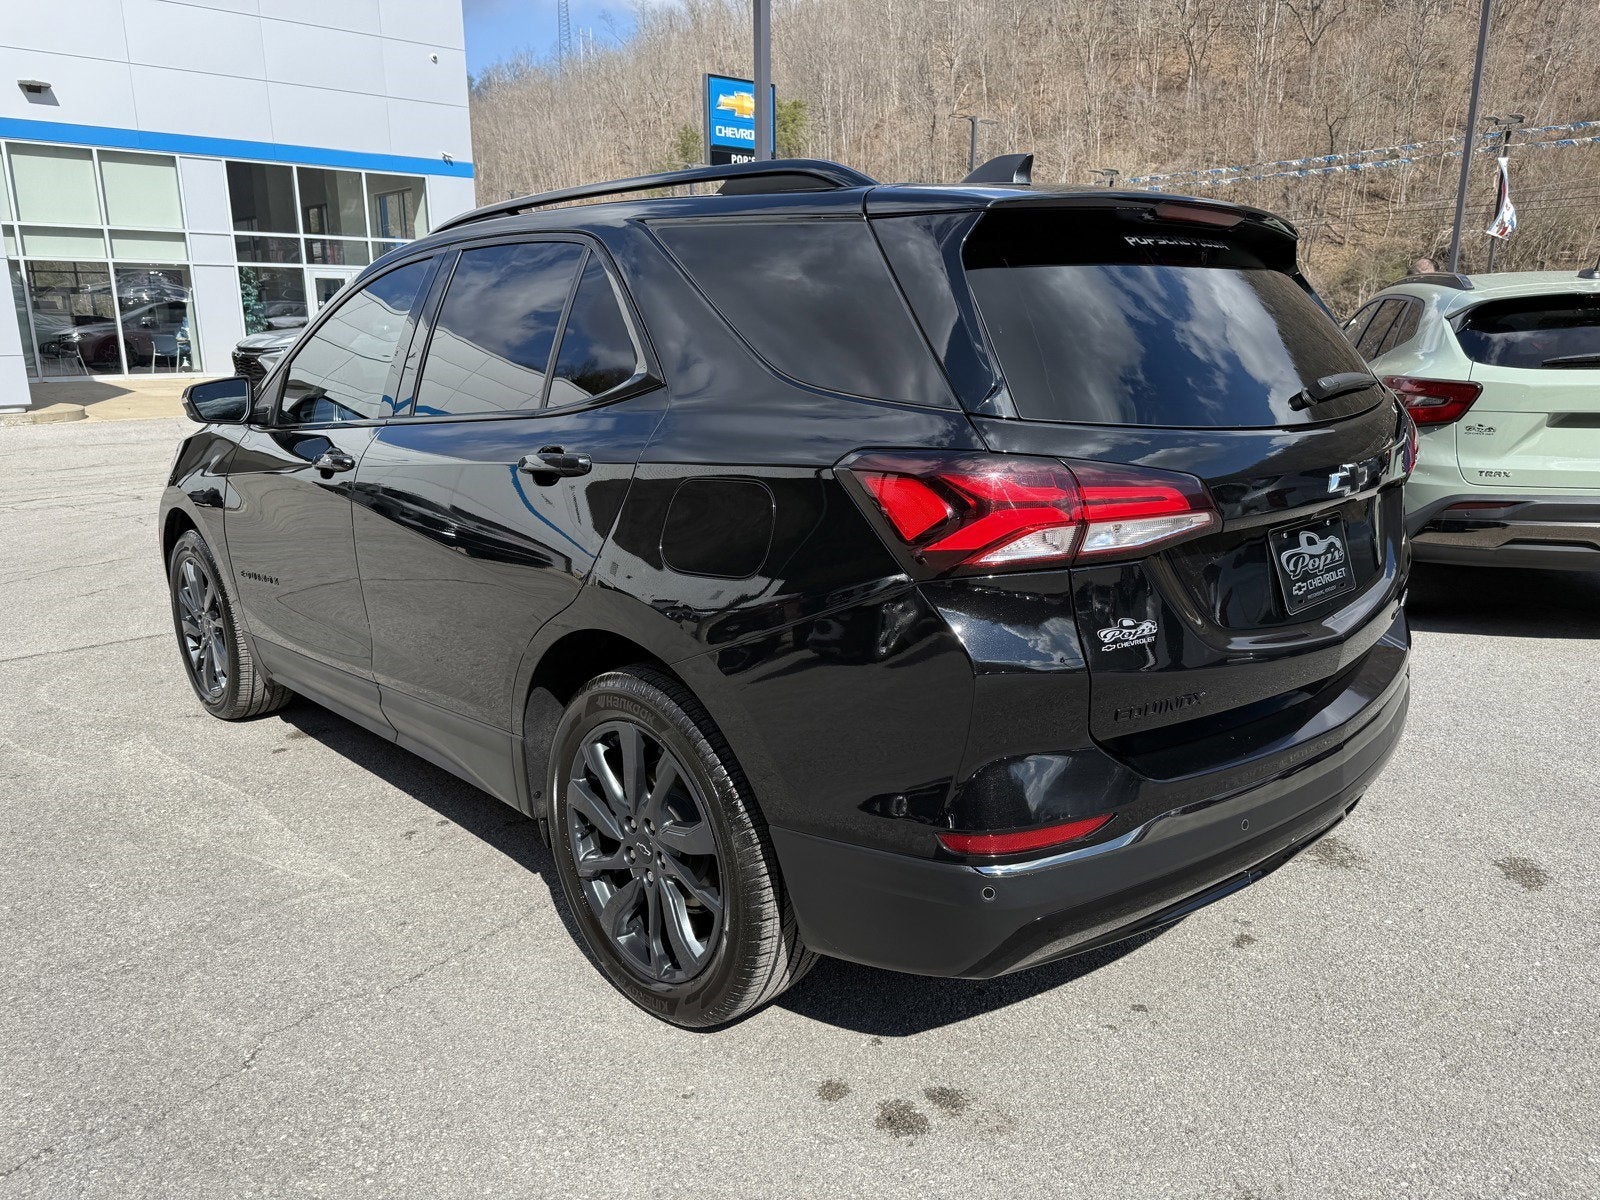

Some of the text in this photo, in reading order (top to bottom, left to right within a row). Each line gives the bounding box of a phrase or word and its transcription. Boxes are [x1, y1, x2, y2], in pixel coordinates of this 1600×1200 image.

[715, 125, 755, 141] CHEVRO
[1478, 470, 1512, 478] TRAX
[1307, 567, 1347, 591] CHEVROLET
[1117, 636, 1156, 649] CHEVROLET
